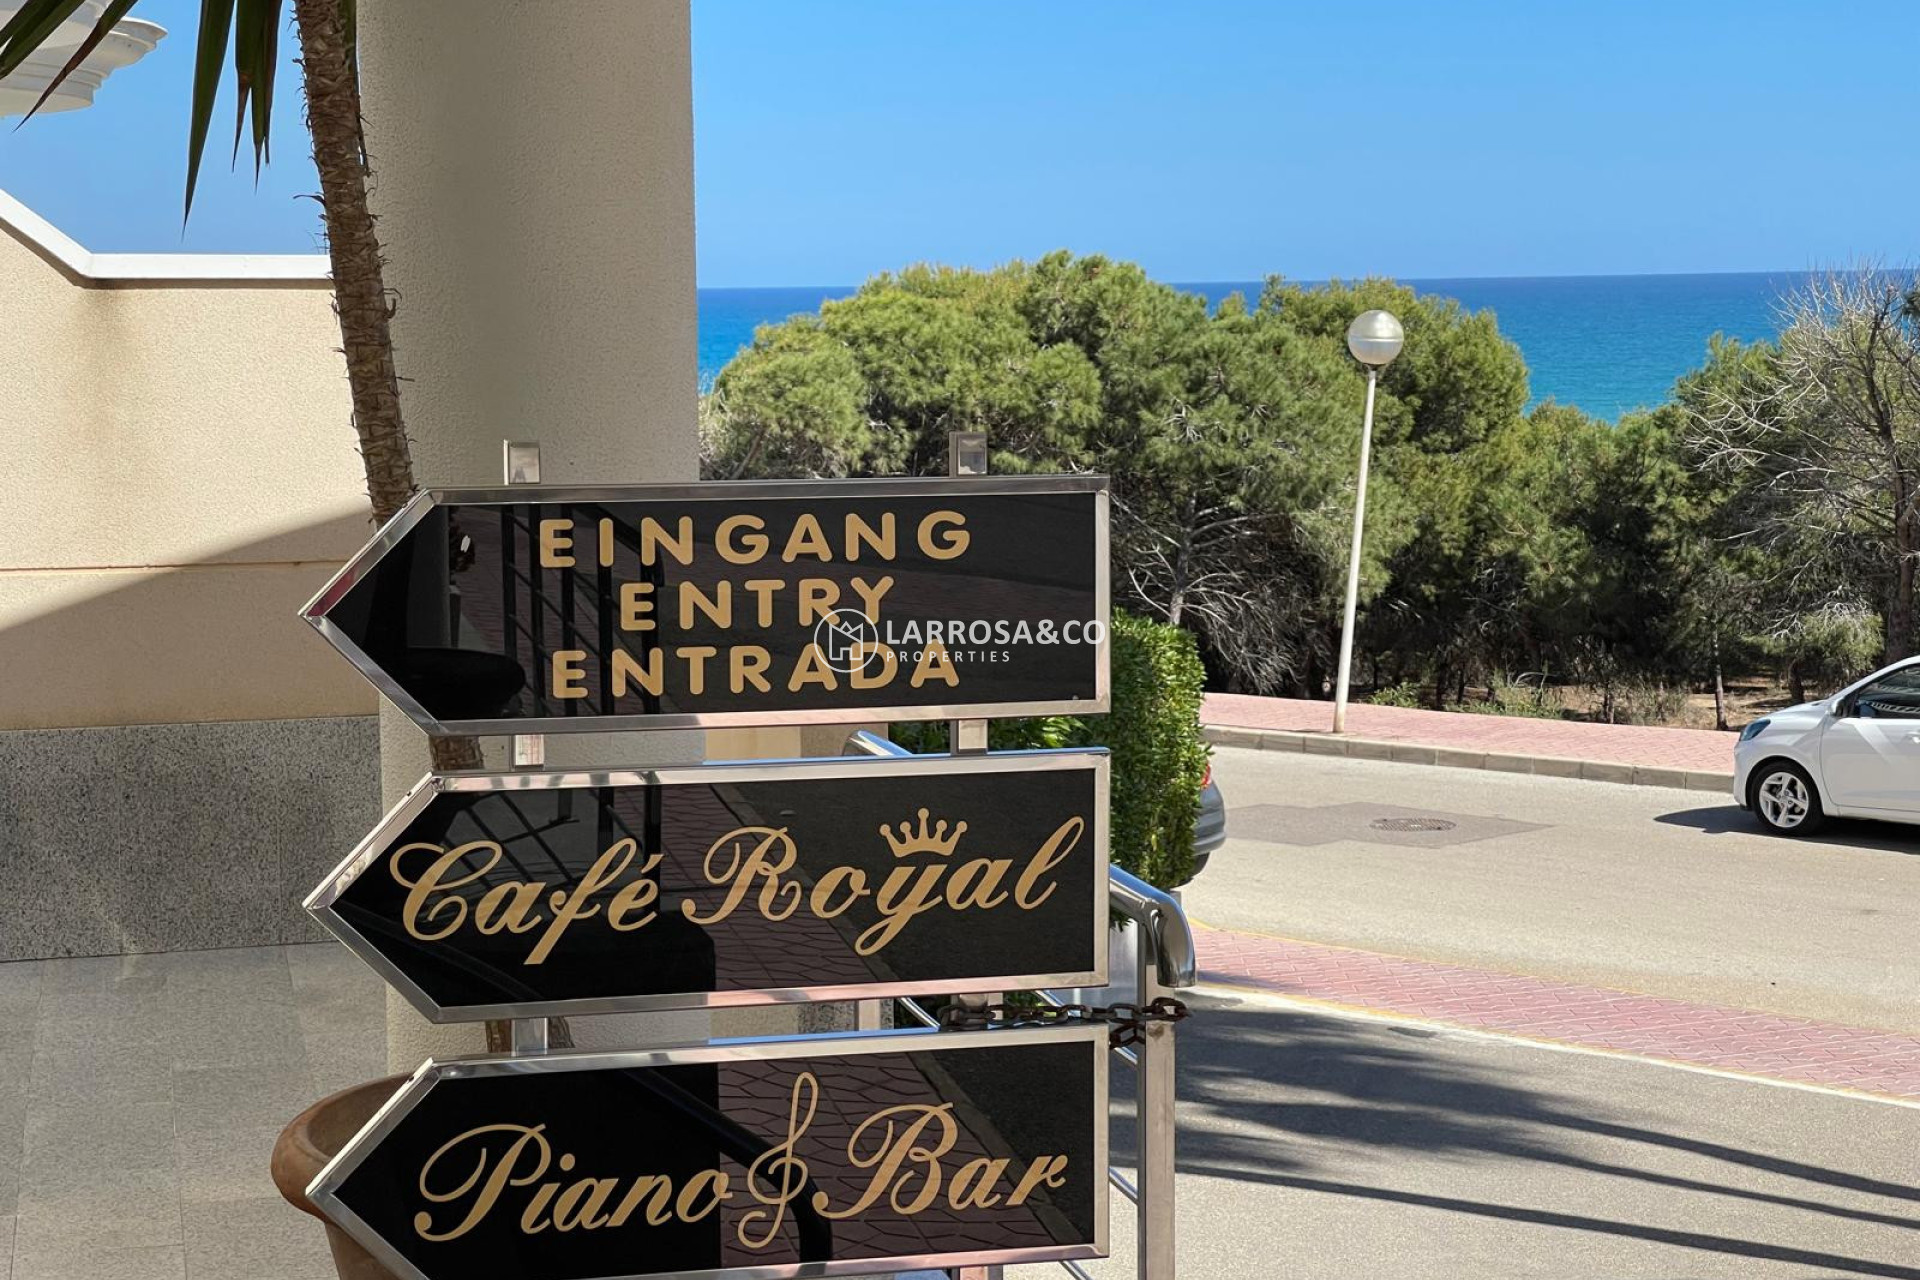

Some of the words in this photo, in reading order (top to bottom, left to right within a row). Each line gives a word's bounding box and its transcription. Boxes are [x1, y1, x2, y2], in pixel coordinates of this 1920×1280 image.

[539, 510, 972, 569] EINGANG
[619, 576, 895, 632] ENTRY
[552, 639, 960, 700] ENTRADA
[389, 837, 663, 965] Café
[681, 815, 1085, 957] Royal
[413, 1123, 732, 1242] Piano
[813, 1102, 1068, 1219] Bar
